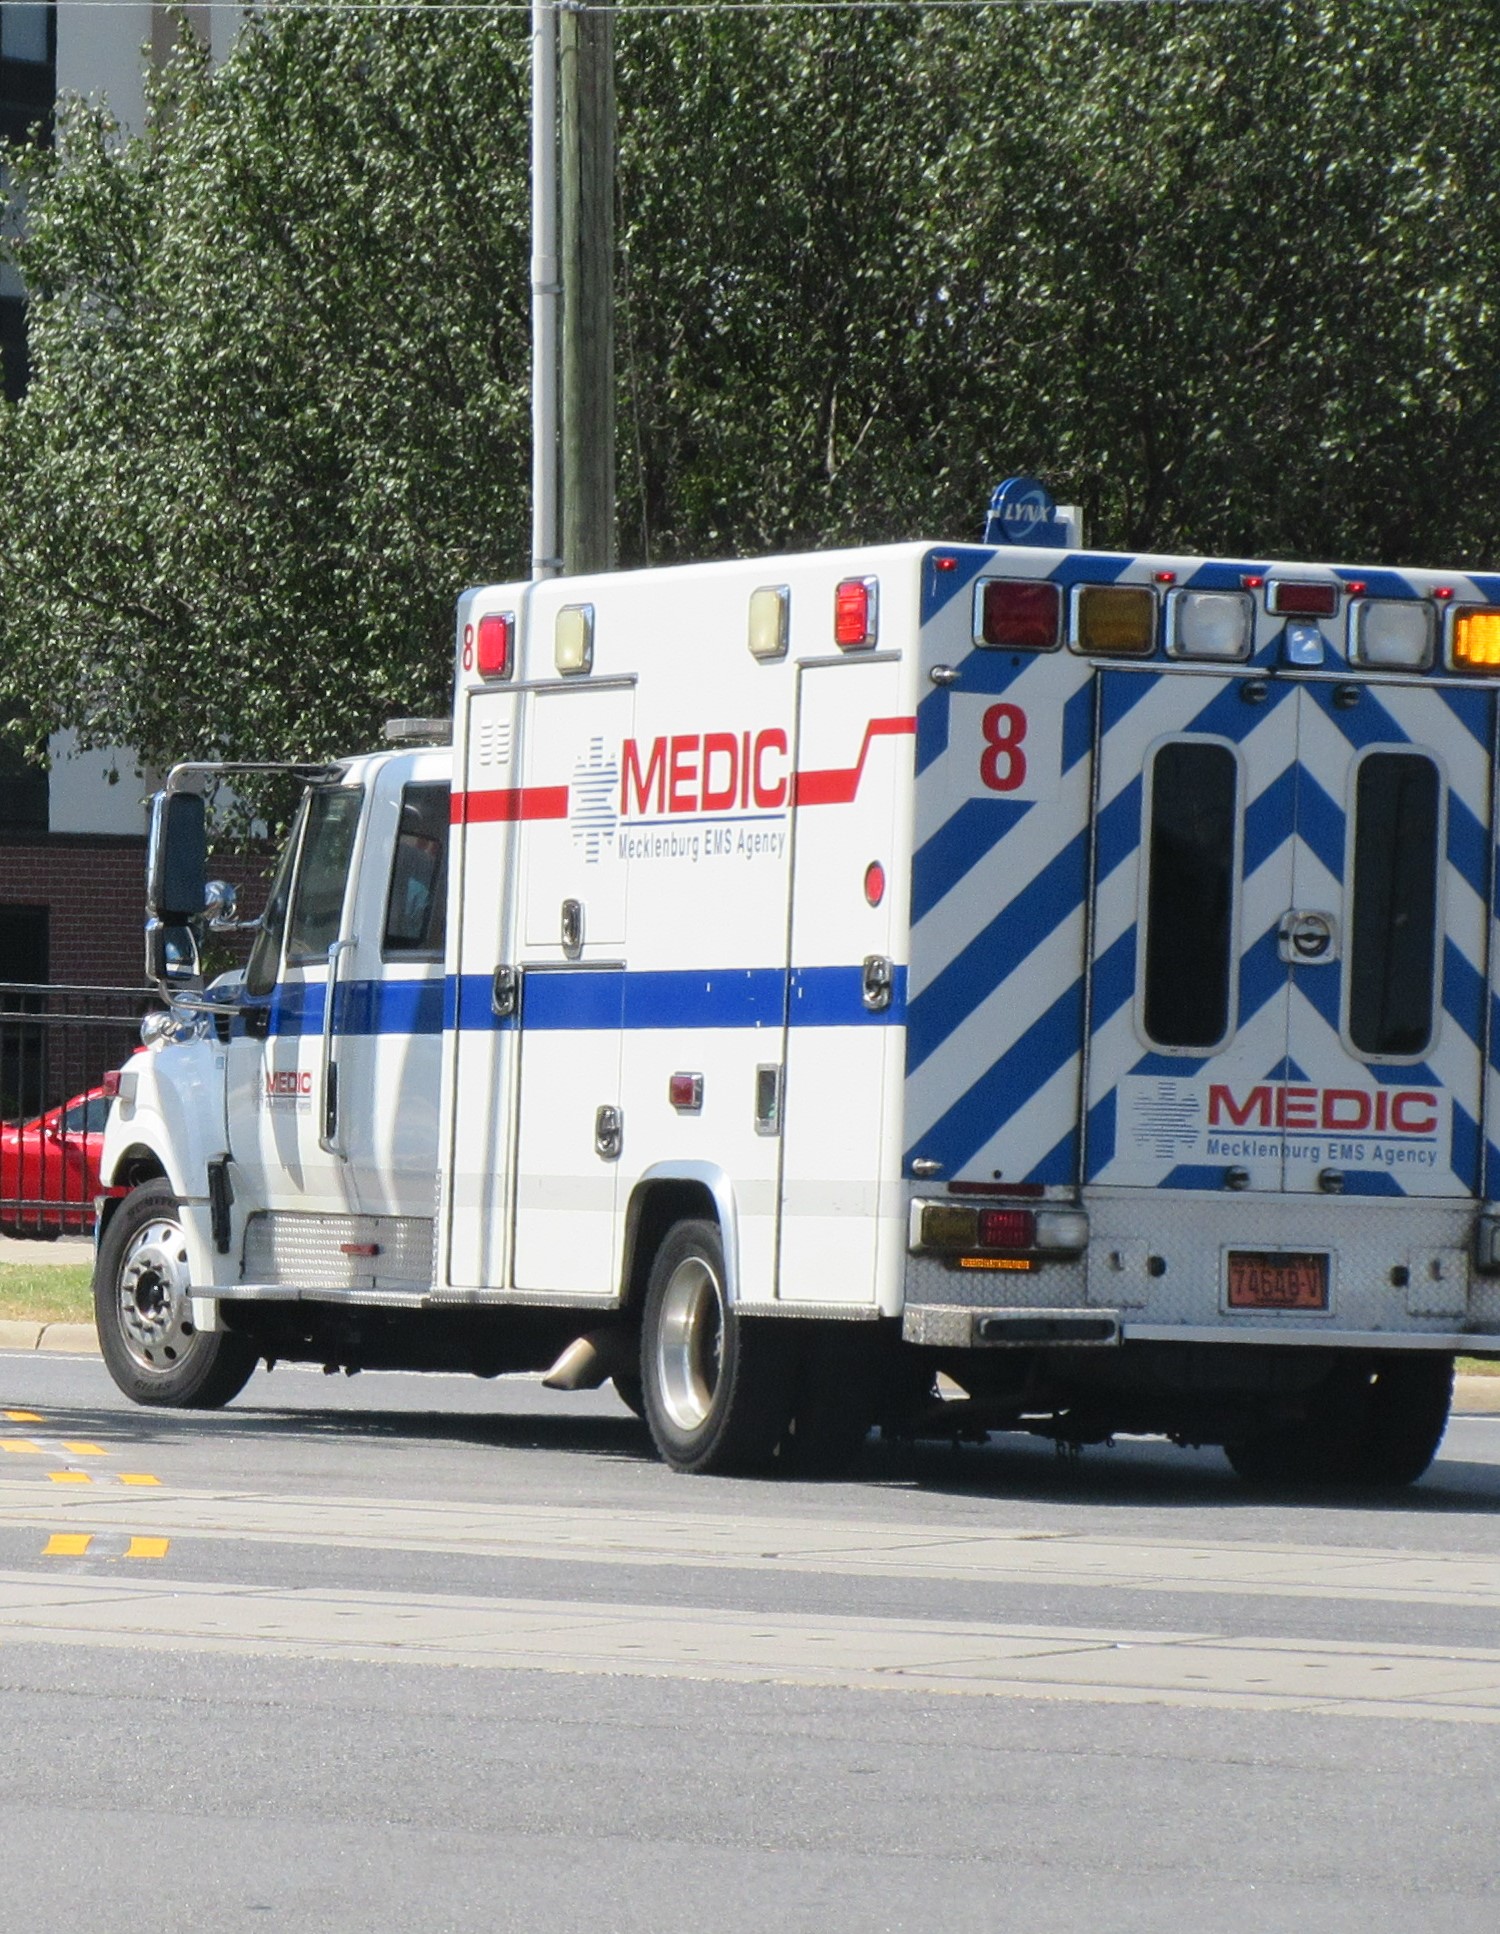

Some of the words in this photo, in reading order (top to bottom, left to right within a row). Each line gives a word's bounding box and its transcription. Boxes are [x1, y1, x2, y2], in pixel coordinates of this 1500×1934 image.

[1004, 503, 1051, 522] LYNX
[463, 623, 474, 671] 8
[981, 702, 1027, 791] 8
[620, 728, 788, 815] MEDIC
[619, 831, 700, 862] Mecklenburg
[705, 829, 732, 855] EMS
[737, 829, 786, 860] Agency
[266, 1071, 311, 1093] MEDIC
[1208, 1085, 1437, 1133] MEDIC
[1207, 1139, 1320, 1161] Mecklenburg
[1328, 1143, 1365, 1161] EMS
[1372, 1145, 1437, 1166] Agency
